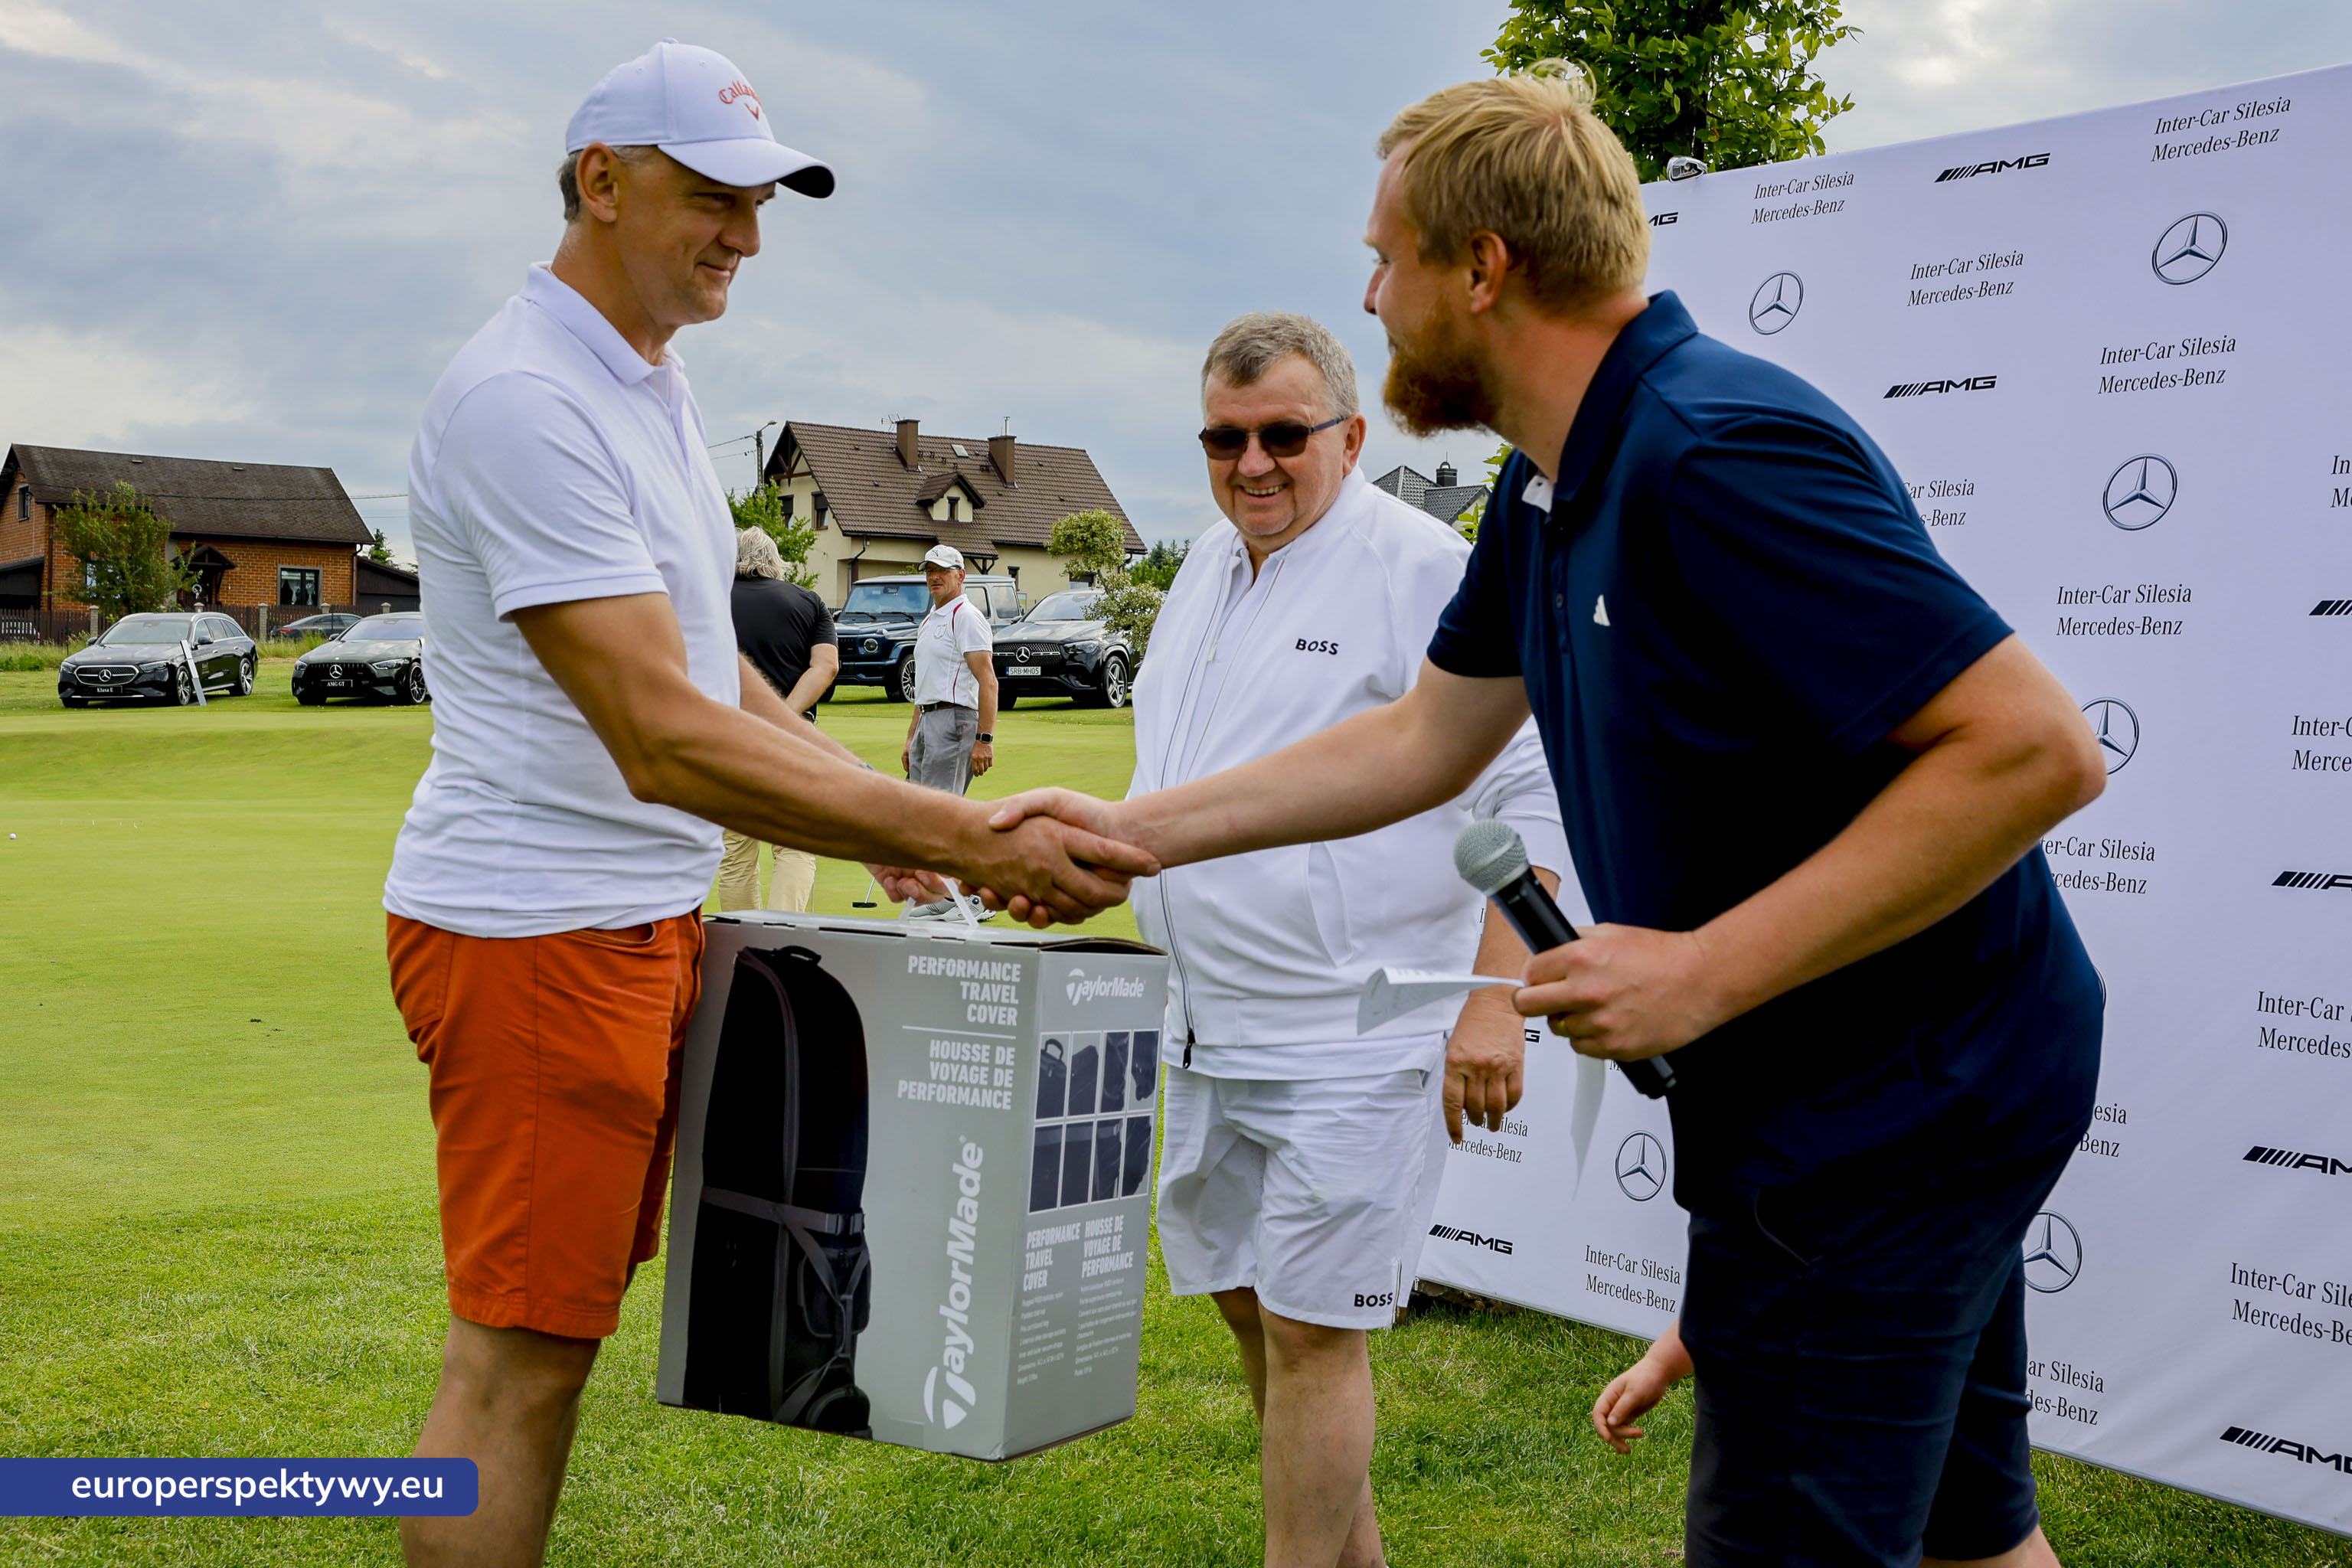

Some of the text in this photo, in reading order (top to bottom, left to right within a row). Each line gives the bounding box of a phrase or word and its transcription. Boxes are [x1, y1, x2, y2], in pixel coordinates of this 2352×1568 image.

[2154, 96, 2291, 136] Inter-Car Silesia
[2151, 128, 2280, 162] Mercedes-Benz
[1969, 153, 2051, 178] AMG
[1754, 171, 1854, 199] Inter-Car Silesia
[1752, 199, 1845, 224] Mercedes-Benz
[1910, 250, 2024, 280] Inter-Car Silesia
[1906, 280, 2014, 307] Mercedes-Benz
[2099, 335, 2236, 365] Inter-Car Silesia
[1918, 374, 1998, 396] AMG
[2098, 368, 2226, 394] Mercedes-Benz
[1928, 479, 1975, 498] Silesia
[2056, 583, 2192, 605] Inter-Car Silesia
[2056, 616, 2184, 636] Mercedes-Benz
[1295, 638, 1339, 655] BOSS
[2099, 838, 2155, 861] Silesia
[2052, 870, 2147, 894] cedes-Benz
[908, 955, 1021, 982] PERFORMANCE
[960, 981, 1019, 1004] TRAVEL
[1066, 968, 1145, 1006] TaylorMade
[967, 1004, 1018, 1026] COVER
[2256, 991, 2345, 1021] Inter-Car
[929, 1040, 1016, 1067] HOUSSE DE
[2258, 1026, 2352, 1059] Mercedes
[929, 1062, 1014, 1088] VOYAGE DE
[897, 1080, 1013, 1110] PERFORMANCE
[1501, 1117, 1528, 1137] ilesia
[2094, 1103, 2127, 1125] esia
[1026, 1222, 1081, 1250] PERFORMANCE
[1084, 1214, 1124, 1238] HOUSSE DE
[1083, 1234, 1122, 1258] VOYAGE DE
[1455, 1230, 1514, 1256] AMG
[1024, 1248, 1053, 1270] TRAVEL
[1081, 1251, 1134, 1278] PERFORMANCE
[1585, 1244, 1681, 1285] Inter-Car Silesia
[923, 1142, 984, 1430] TaylorMade
[1023, 1269, 1048, 1292] COVER
[1586, 1273, 1676, 1313] Mercedes-Benz
[2230, 1263, 2316, 1300] Inter-Car
[1354, 1292, 1393, 1308] BOSS
[2232, 1298, 2352, 1346] Mercedes-Be
[2050, 1361, 2104, 1393] Silesia
[2025, 1390, 2099, 1426] des-Benz
